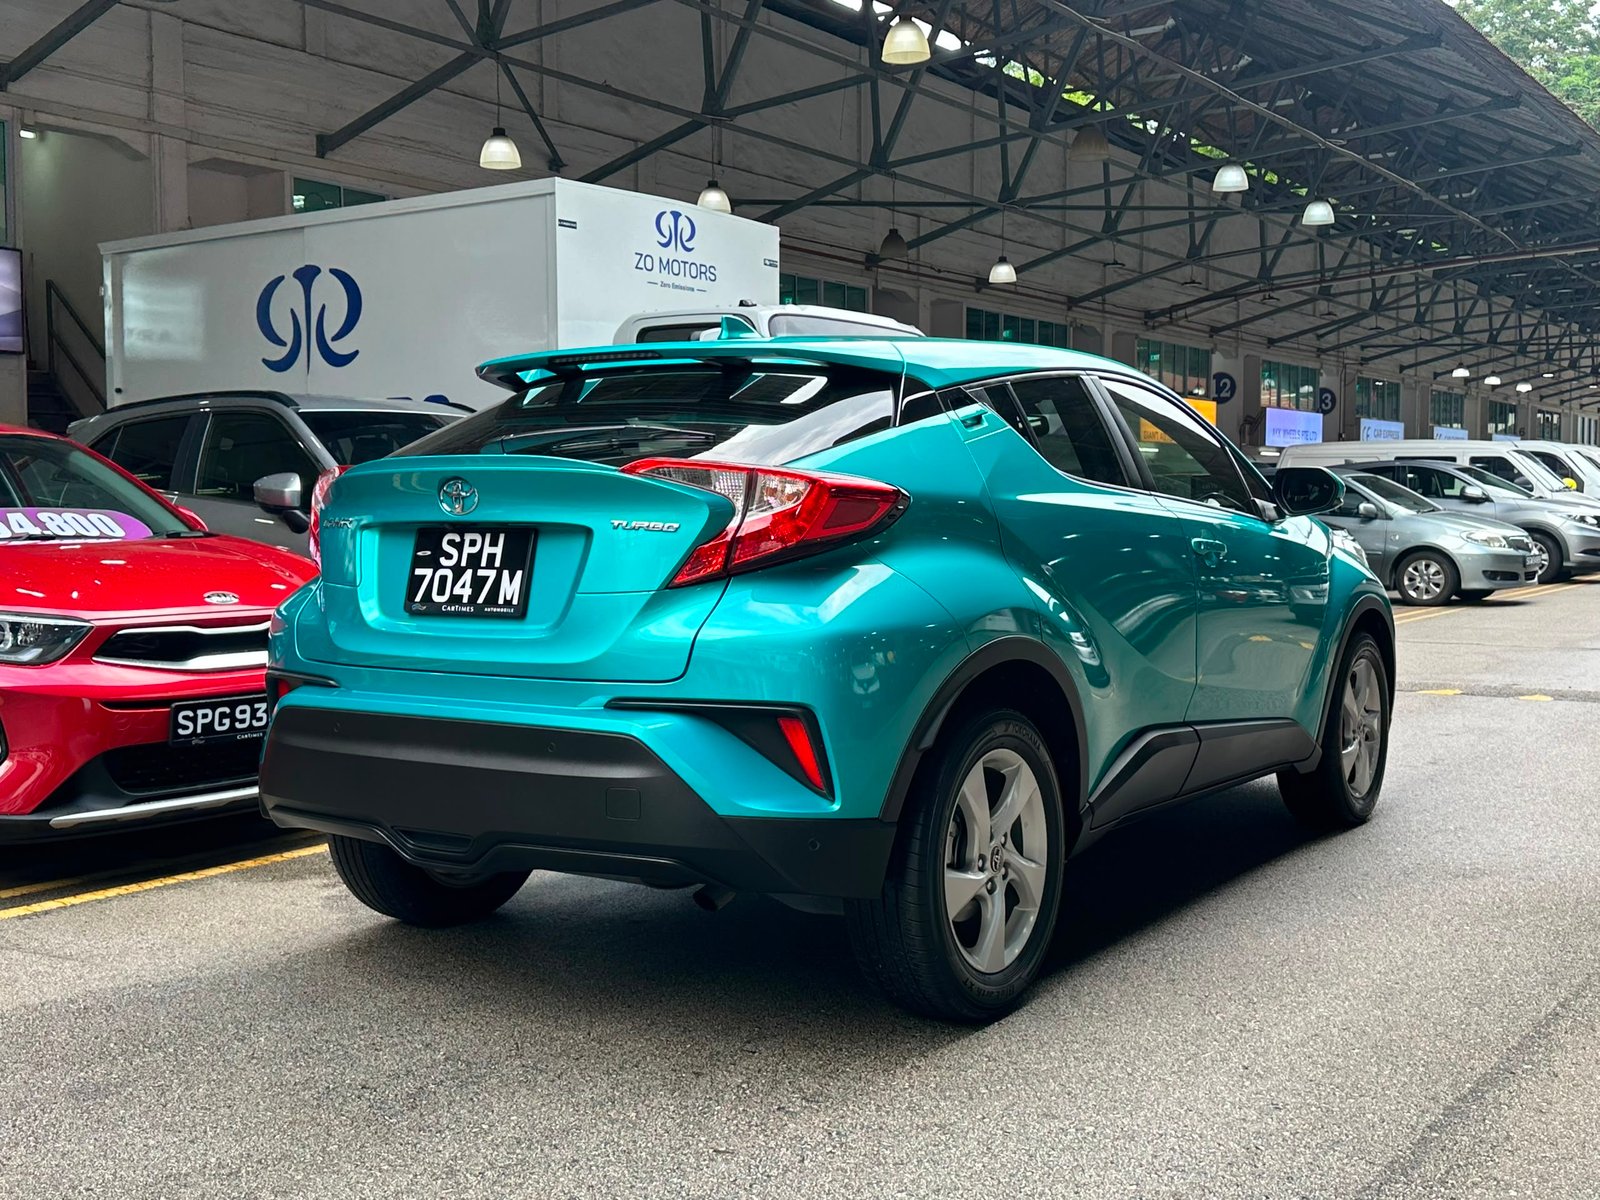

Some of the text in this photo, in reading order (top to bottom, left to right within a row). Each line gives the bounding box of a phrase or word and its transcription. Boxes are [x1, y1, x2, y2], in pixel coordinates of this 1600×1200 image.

[635, 252, 717, 282] ZO MOTORS
[660, 281, 695, 292] Zero Emissions
[1321, 392, 1332, 411] 3
[1519, 428, 1526, 437] 6
[610, 519, 681, 533] TURBO
[439, 533, 505, 567] SPH
